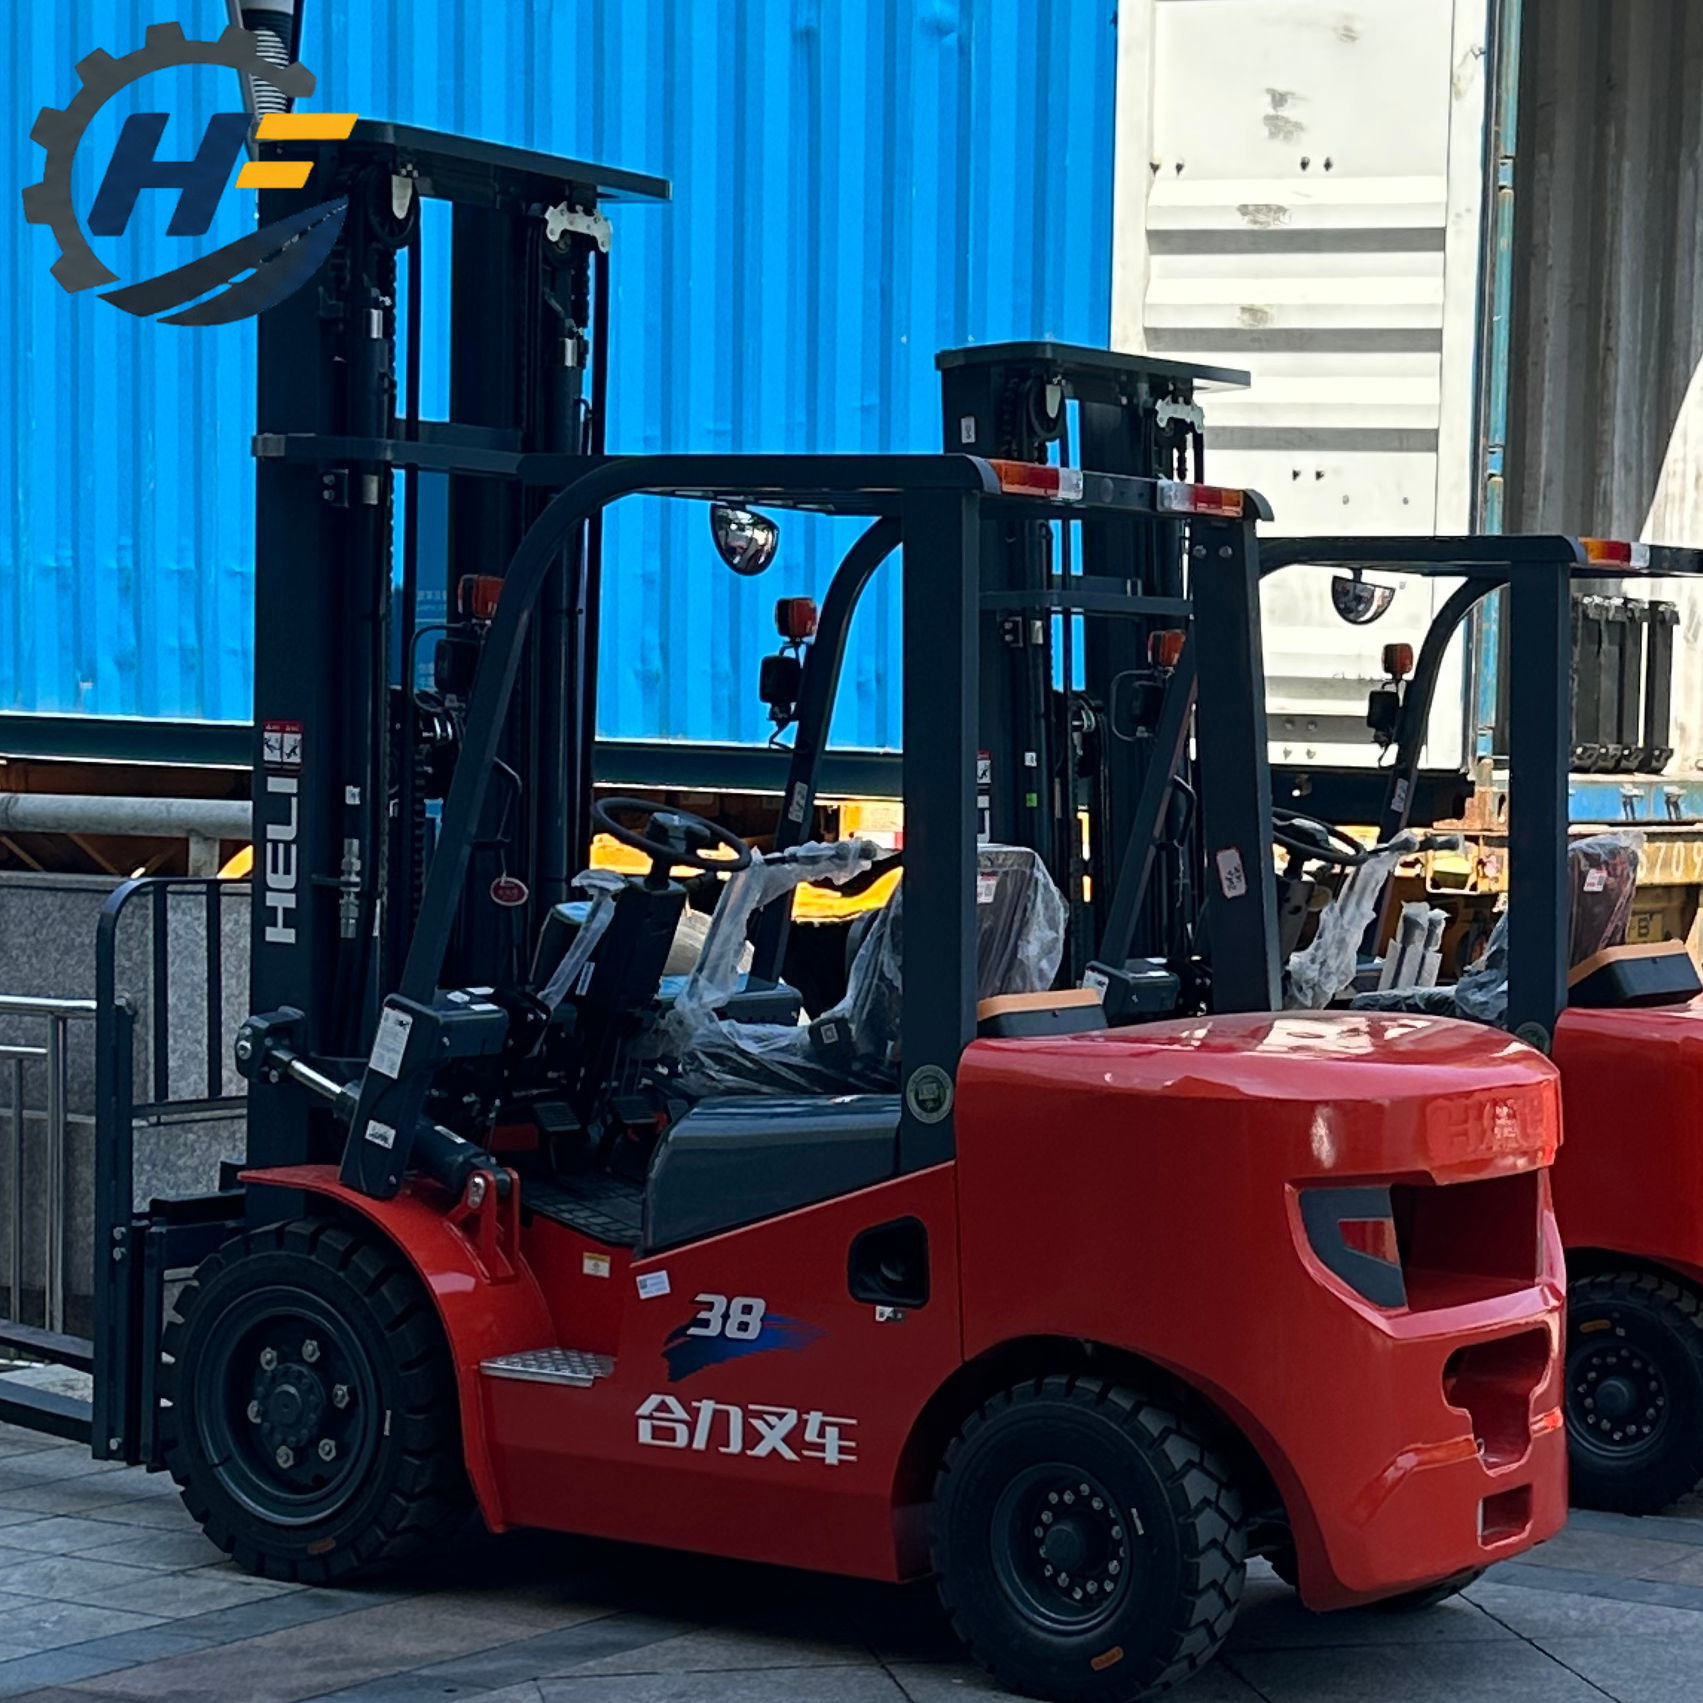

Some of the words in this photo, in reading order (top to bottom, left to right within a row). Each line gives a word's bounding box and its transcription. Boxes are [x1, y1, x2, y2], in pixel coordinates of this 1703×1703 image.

[265, 776, 298, 944] HELI
[687, 1293, 766, 1340] 38
[634, 1393, 858, 1465] 合力叉车
